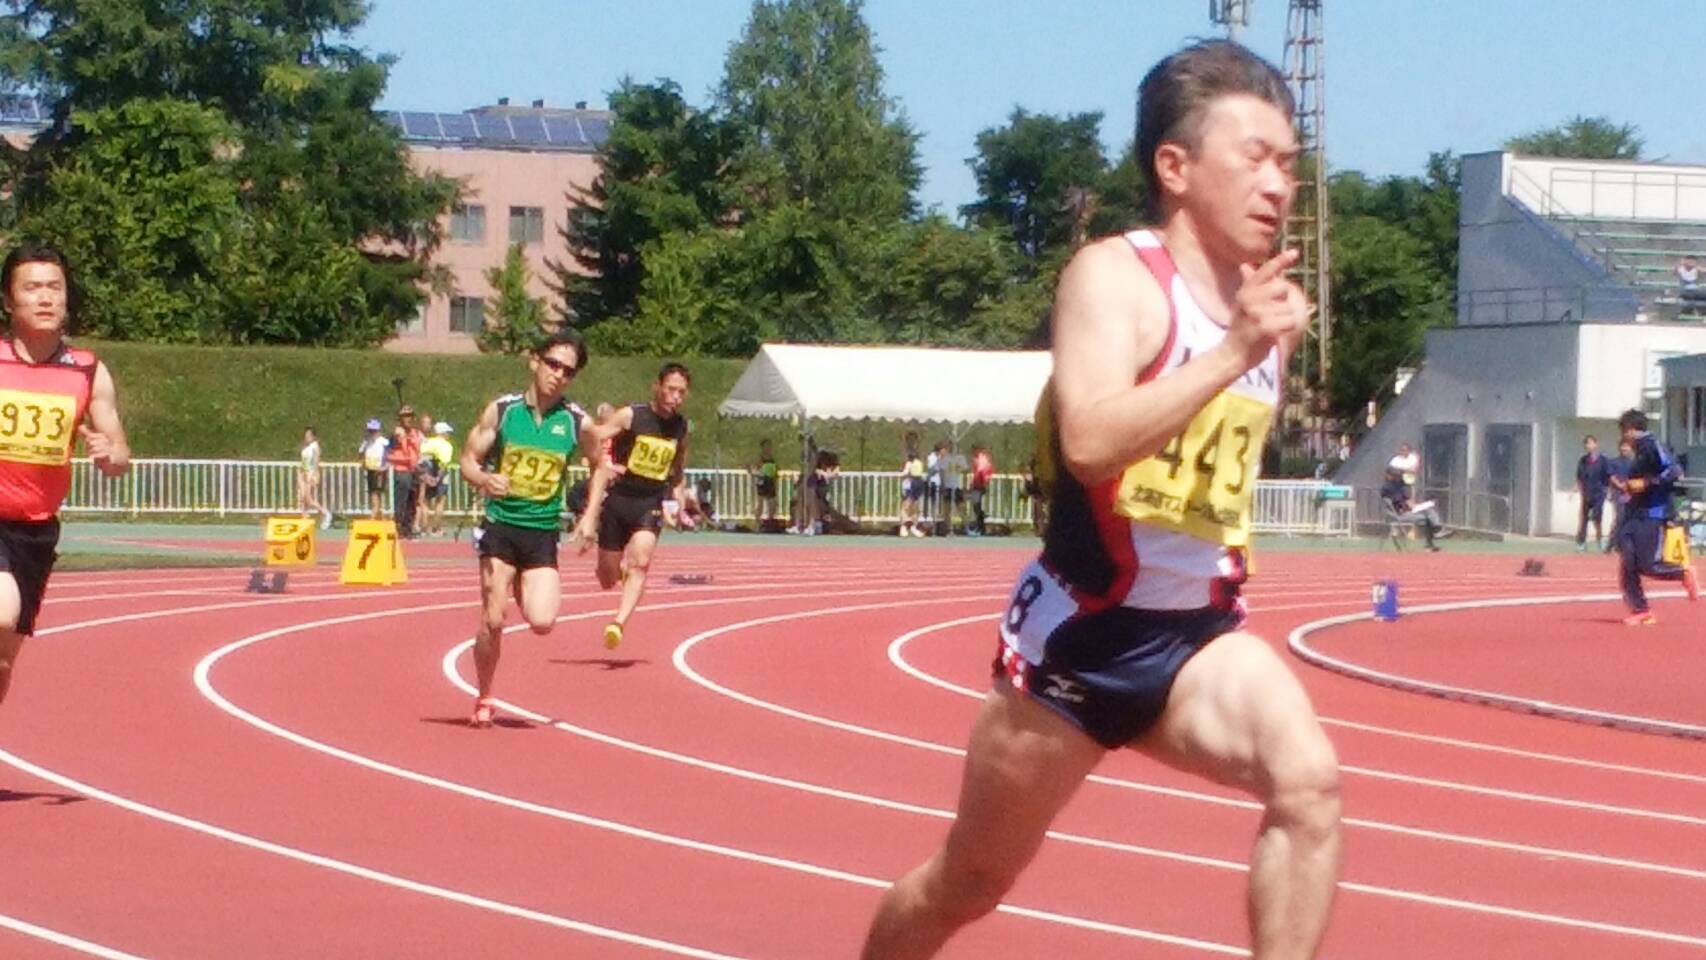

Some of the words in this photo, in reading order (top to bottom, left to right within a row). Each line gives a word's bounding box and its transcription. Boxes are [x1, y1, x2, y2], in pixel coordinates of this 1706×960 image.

[1, 402, 65, 440] 933
[1155, 417, 1250, 495] 443
[355, 532, 381, 570] 7
[1007, 575, 1043, 634] 8
